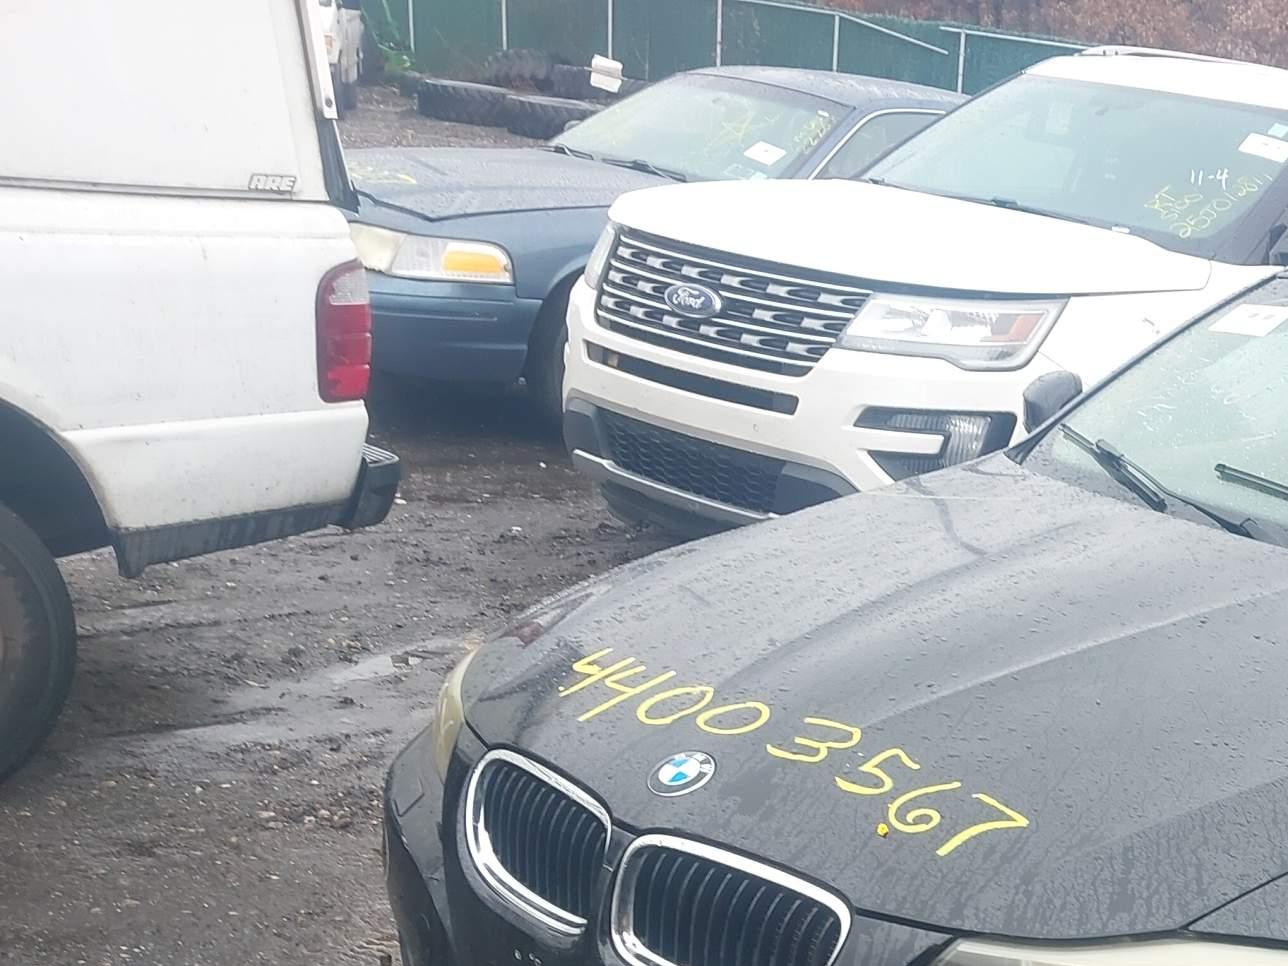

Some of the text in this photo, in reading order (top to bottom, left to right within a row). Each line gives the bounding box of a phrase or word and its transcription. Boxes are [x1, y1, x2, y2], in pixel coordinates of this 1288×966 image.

[248, 173, 297, 191] ARE
[1189, 168, 1229, 191] 11-4
[672, 286, 706, 309] Ford
[558, 647, 1030, 856] 44003567
